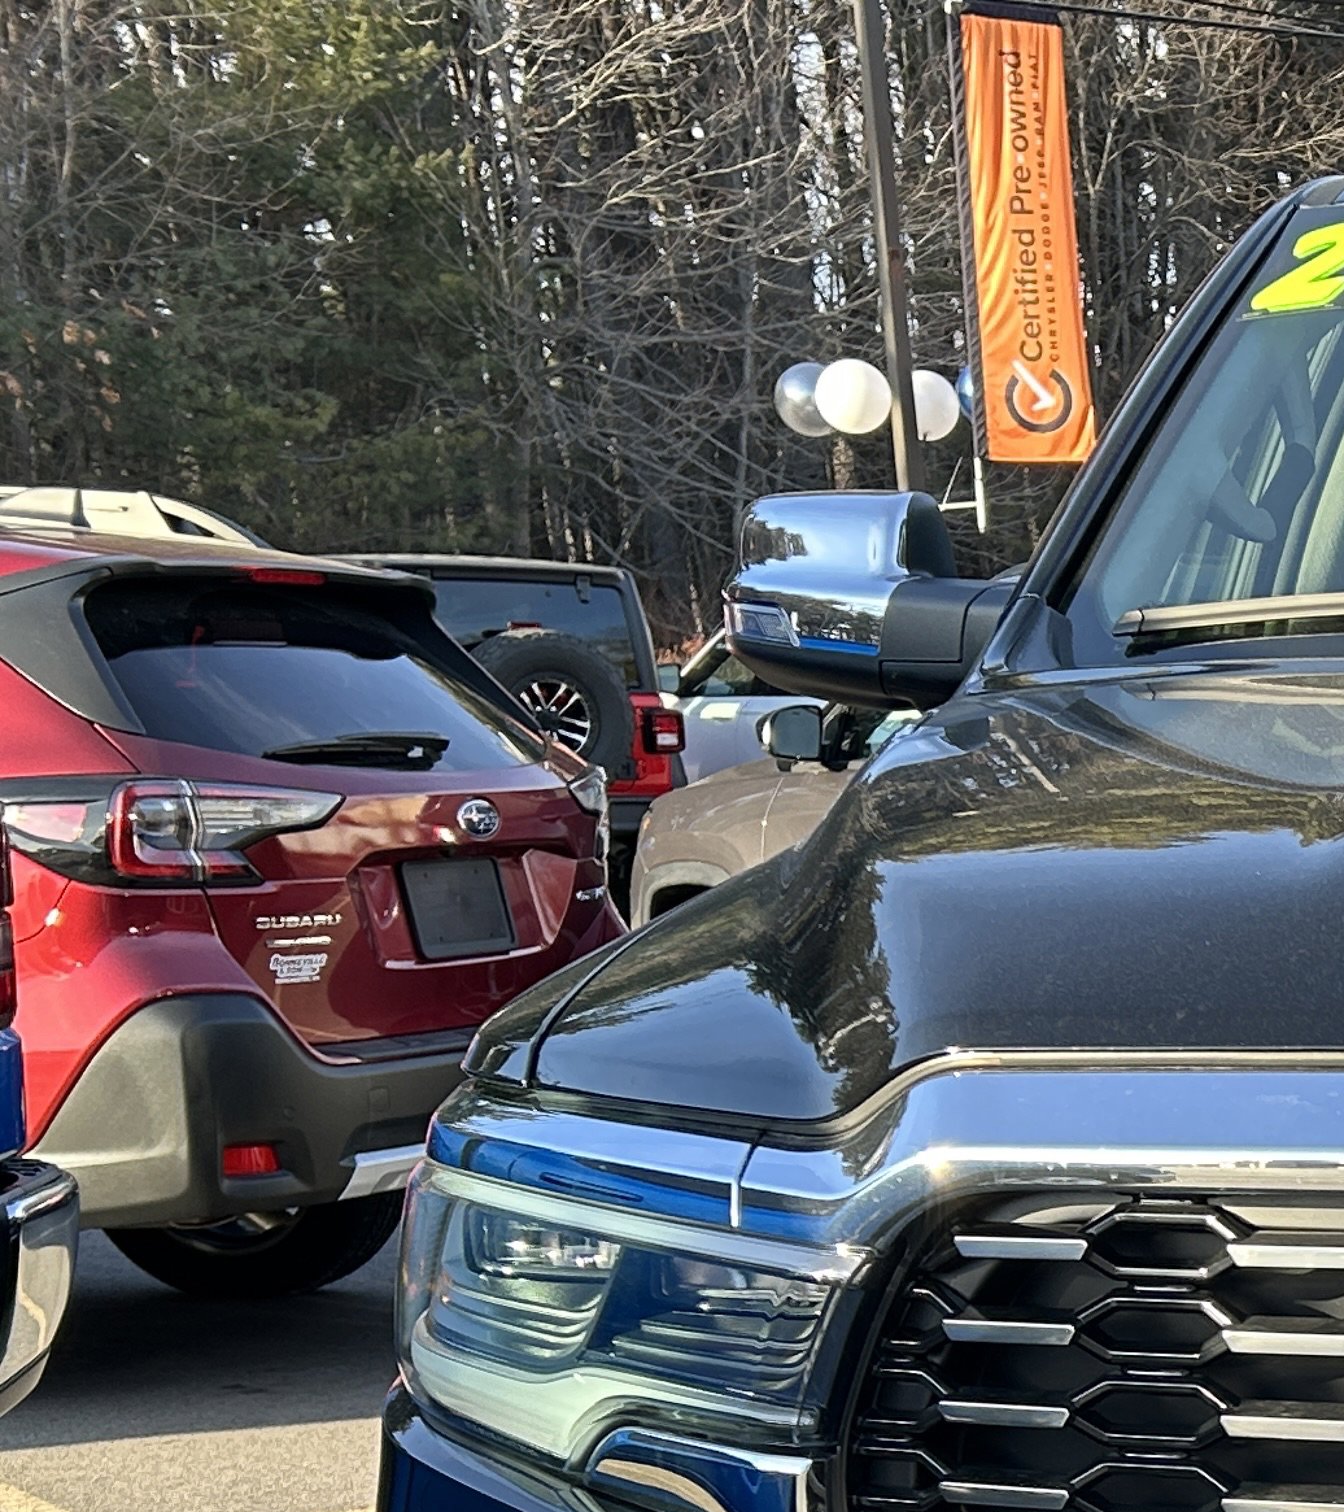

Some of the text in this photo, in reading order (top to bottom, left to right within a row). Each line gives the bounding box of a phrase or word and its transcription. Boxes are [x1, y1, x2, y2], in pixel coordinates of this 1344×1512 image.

[1028, 53, 1039, 89] FIAT
[1032, 101, 1045, 136] RAM
[1040, 202, 1052, 260] DODGE
[1011, 229, 1043, 362] Certified
[1045, 273, 1060, 363] CHRYSLER
[256, 913, 342, 930] SUBARU
